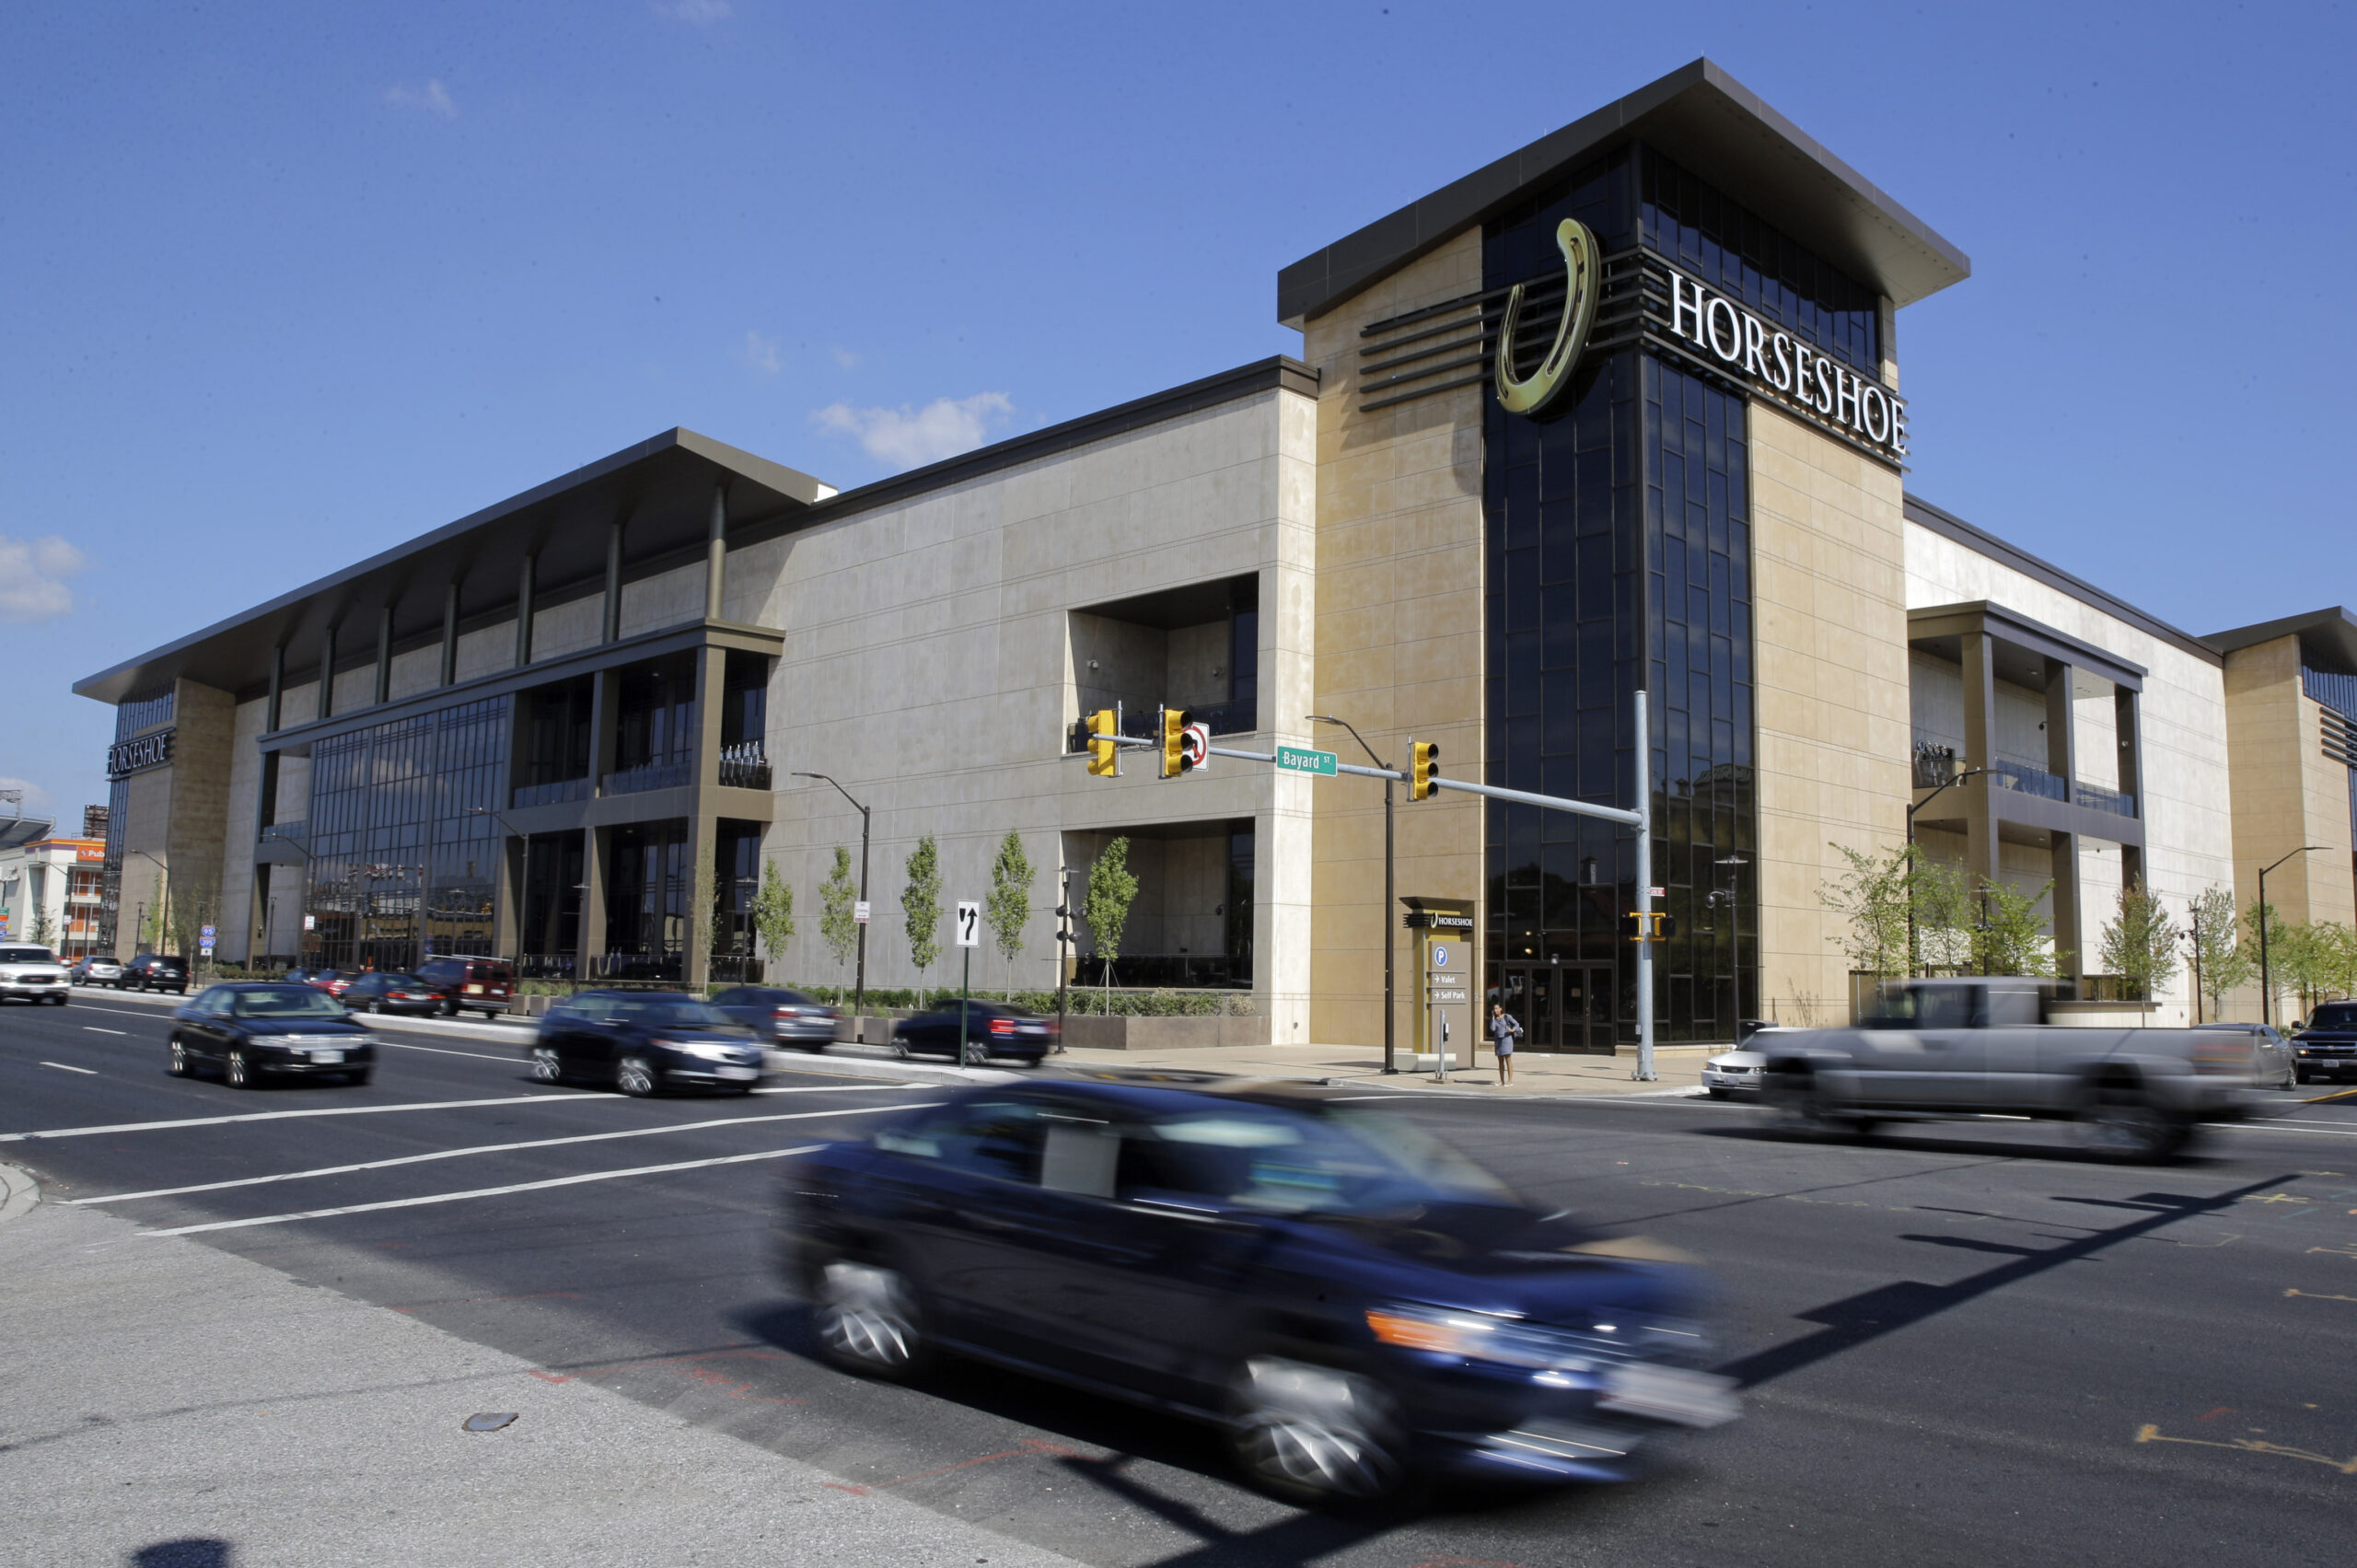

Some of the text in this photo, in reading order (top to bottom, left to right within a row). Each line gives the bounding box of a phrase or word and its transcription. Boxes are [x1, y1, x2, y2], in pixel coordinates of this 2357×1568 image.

[1667, 269, 1907, 457] HORSESHOE
[106, 734, 167, 773] HORSESHOE
[1283, 751, 1319, 771] Bayard
[1438, 917, 1473, 926] HORSESHOE
[1438, 950, 1445, 963] P
[1441, 975, 1456, 983] Valet
[1441, 991, 1466, 1000] Self Park
